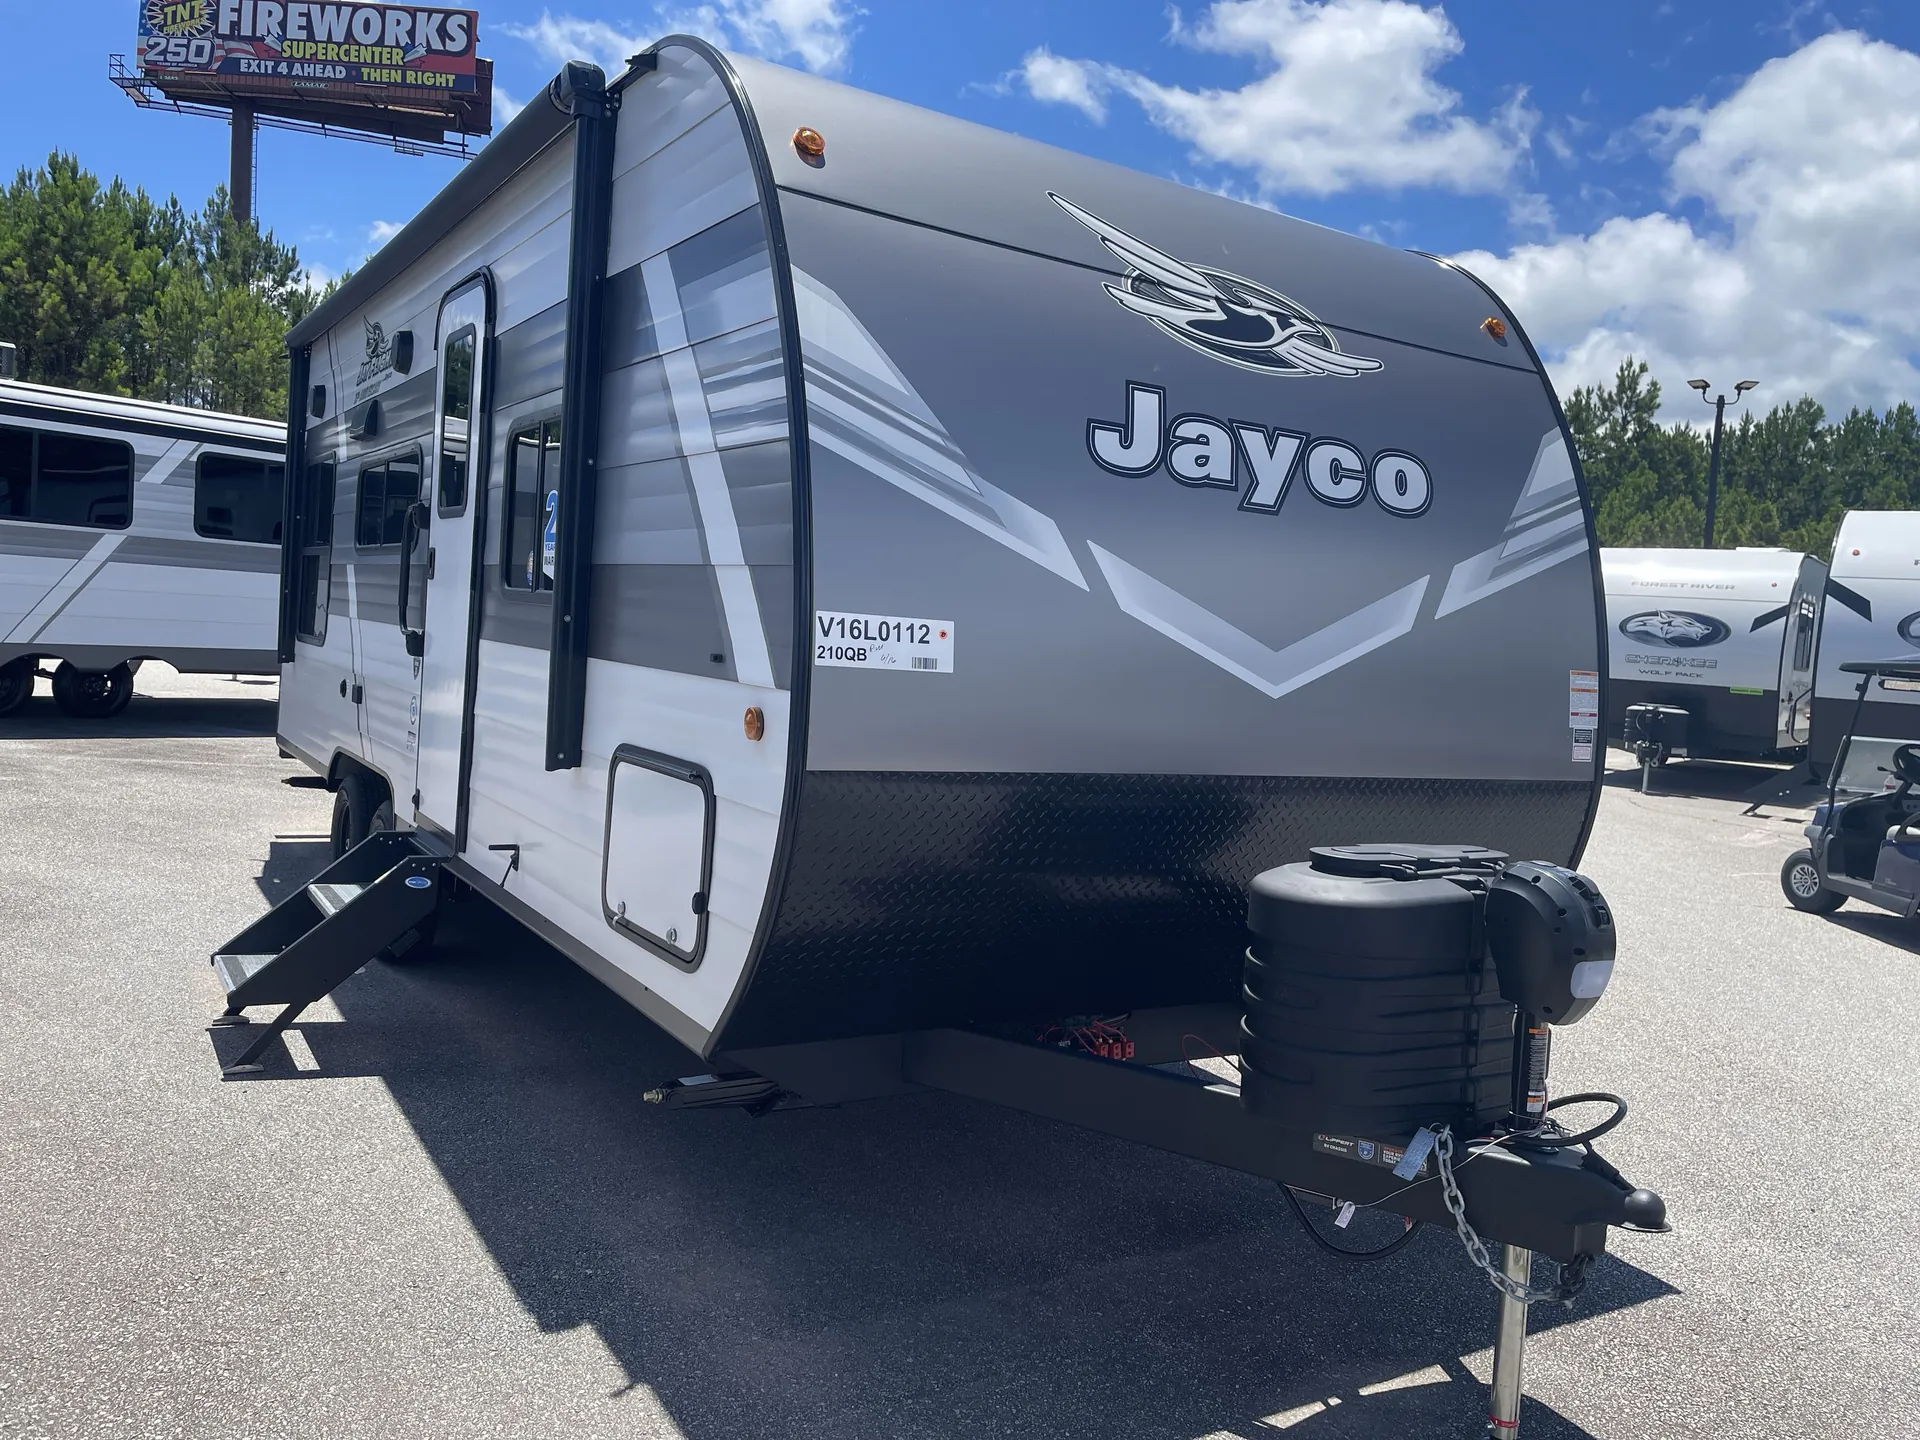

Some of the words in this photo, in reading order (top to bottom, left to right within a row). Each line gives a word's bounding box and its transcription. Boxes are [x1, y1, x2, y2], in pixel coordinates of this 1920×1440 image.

[164, 1, 203, 25] TNT
[218, 0, 468, 52] FIREWORKS
[144, 36, 212, 64] 250
[282, 40, 404, 65] SUPERCENTER
[240, 59, 275, 74] EXIT
[277, 62, 289, 75] 4
[291, 62, 347, 79] AHEAD
[361, 67, 402, 83] THEN
[406, 70, 456, 87] RIGHT
[294, 81, 327, 89] LAMAR
[1086, 379, 1434, 519] Jayco
[545, 489, 559, 543] 2
[1631, 580, 1689, 589] FOREST
[1690, 583, 1736, 591] RIVER
[817, 615, 931, 645] V16L0112
[816, 645, 868, 662] 210QB
[1625, 653, 1718, 669] CHEROKEE
[1638, 669, 1673, 677] WOLF
[1675, 671, 1705, 679] PACK
